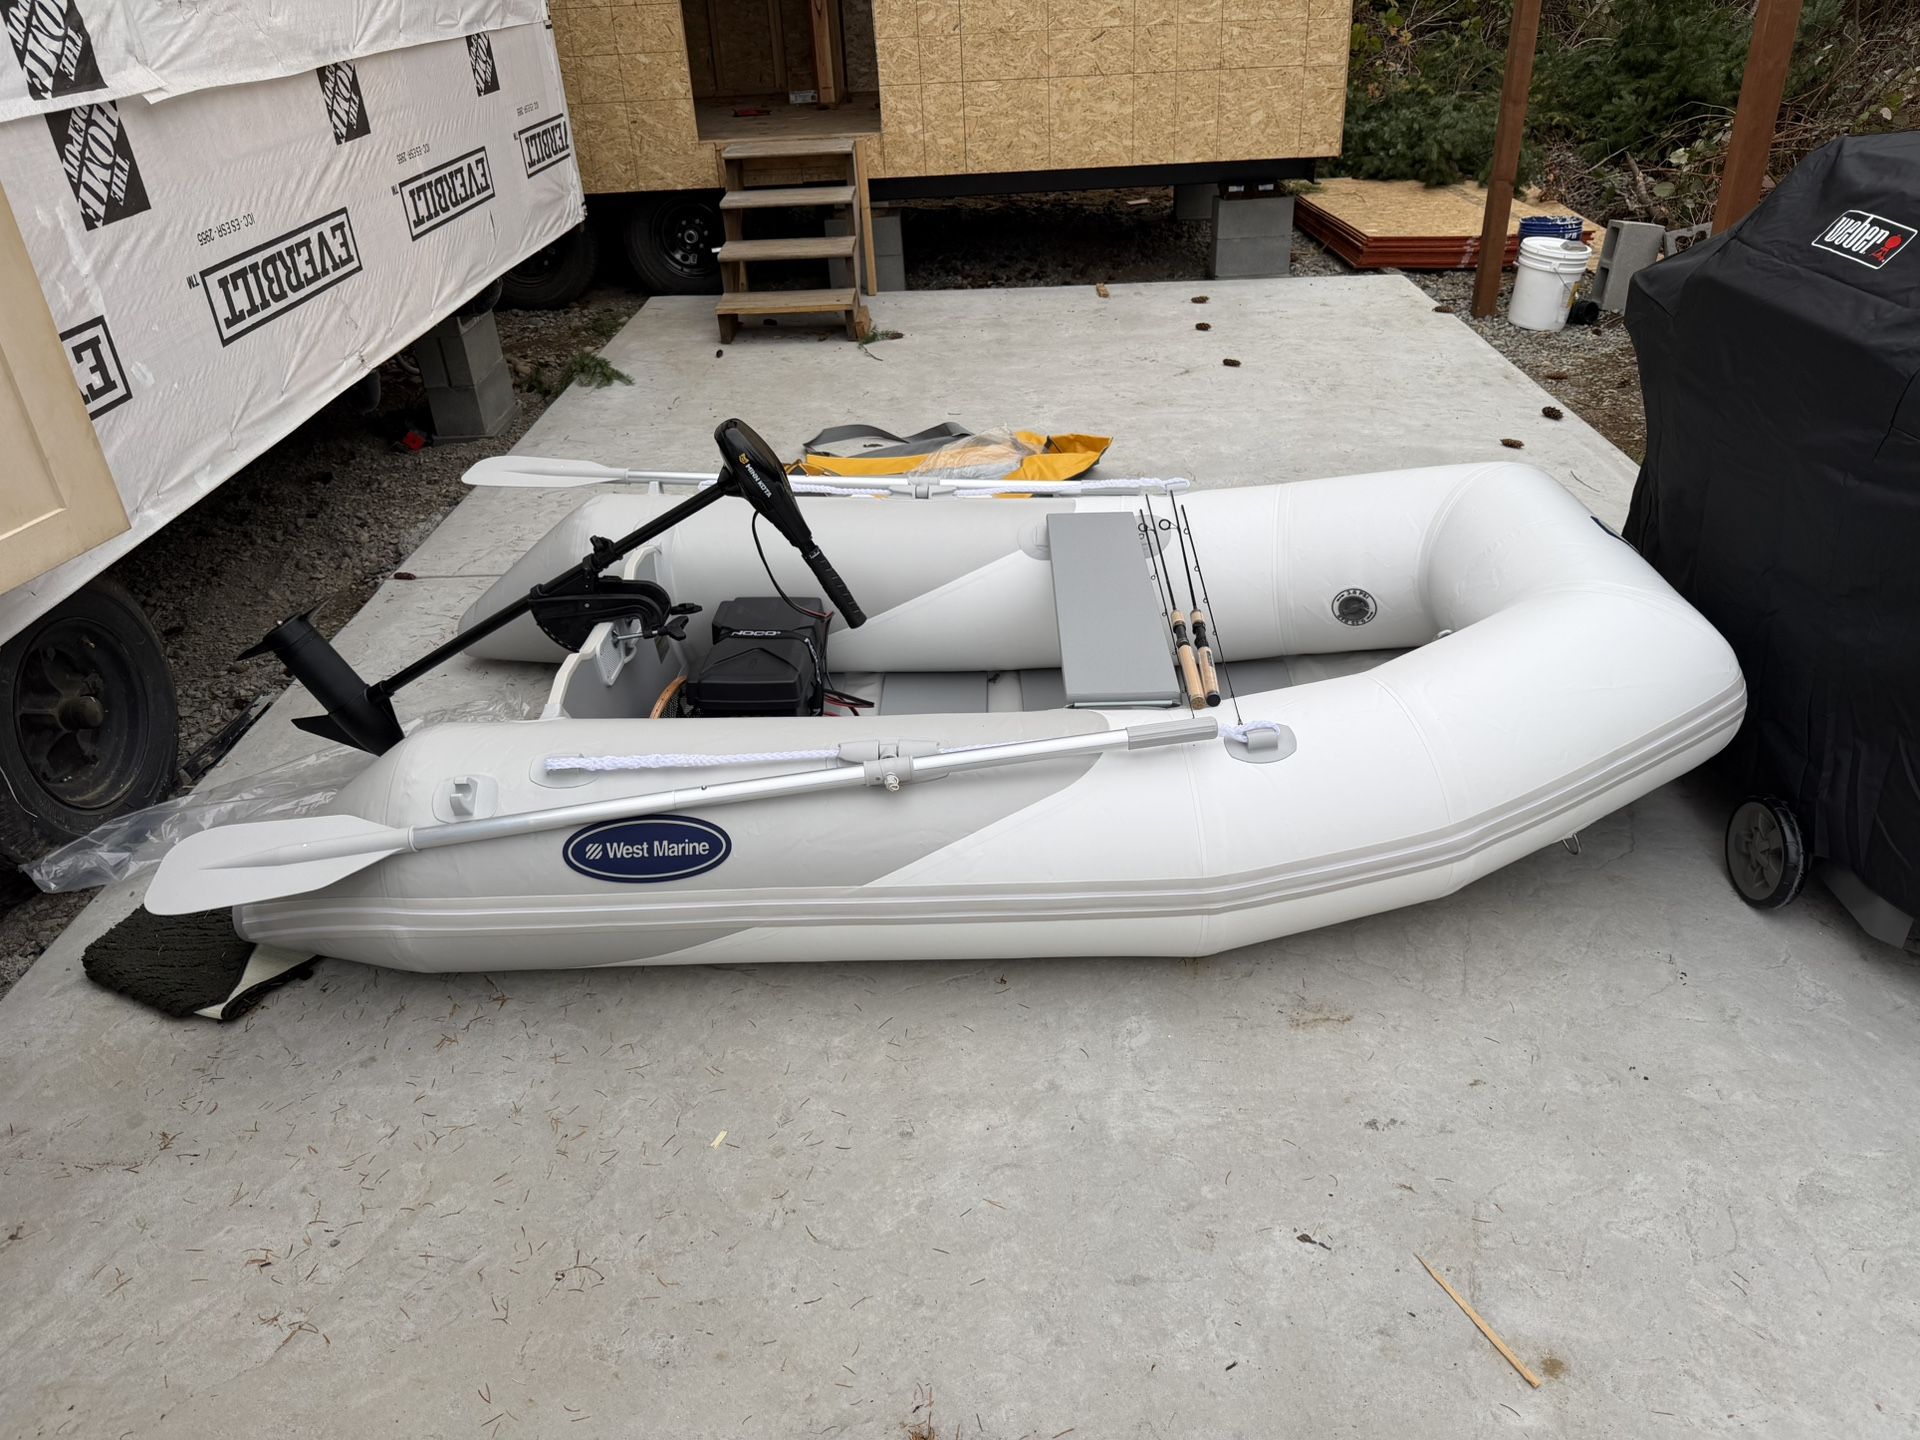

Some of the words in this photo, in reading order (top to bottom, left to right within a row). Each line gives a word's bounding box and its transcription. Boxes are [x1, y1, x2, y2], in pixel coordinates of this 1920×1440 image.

[7, 0, 31, 51] POT
[24, 0, 68, 100] OME
[60, 26, 83, 82] THE
[324, 64, 336, 111] EPOT
[525, 121, 569, 168] ERBILT
[110, 153, 130, 207] THE
[409, 157, 490, 229] EVERBILT
[217, 221, 355, 330] EVERBILT
[606, 841, 649, 859] West
[653, 838, 710, 858] Marine
